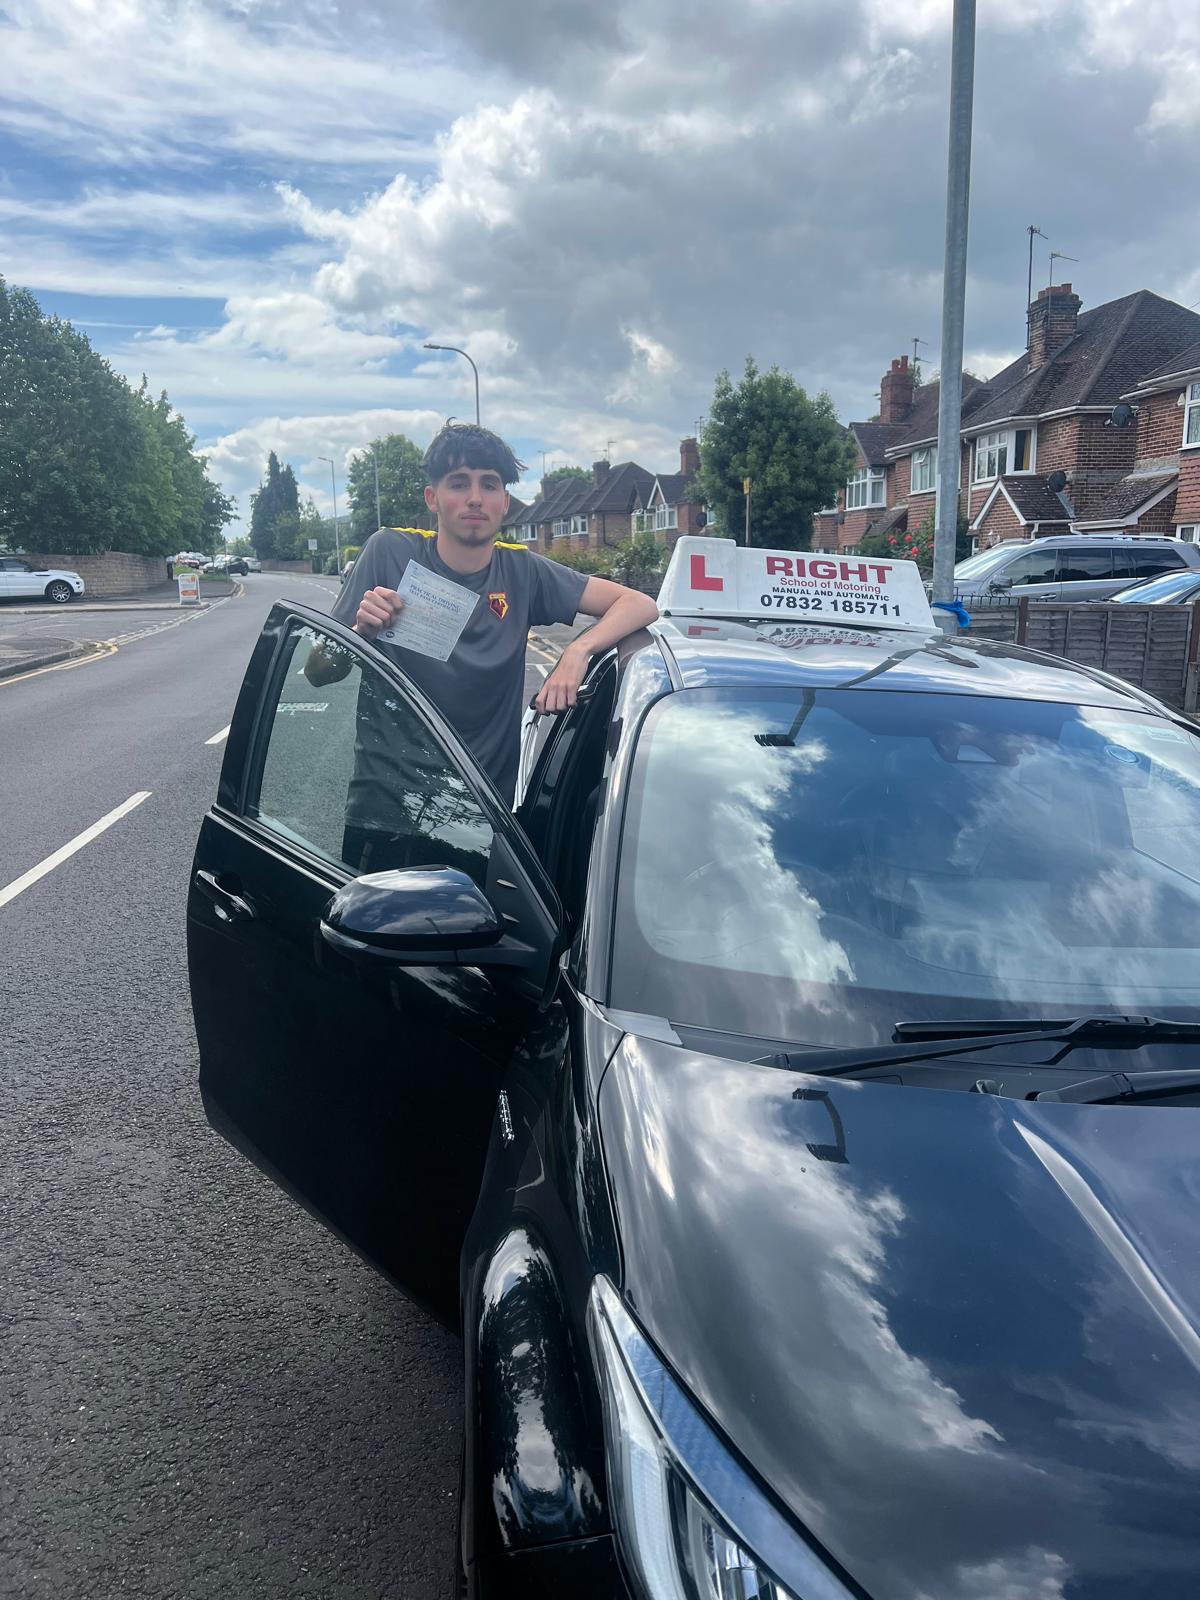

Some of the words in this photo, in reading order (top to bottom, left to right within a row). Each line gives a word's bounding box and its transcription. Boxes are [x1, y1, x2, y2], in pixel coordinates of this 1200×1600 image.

[690, 555, 723, 592] L
[766, 556, 893, 584] RIGHT
[772, 587, 812, 596] MANUAL
[836, 591, 890, 602] AUTOMATIC
[780, 577, 818, 589] School
[820, 580, 833, 590] of
[834, 582, 881, 594] Motoring
[760, 594, 823, 611] 07832
[830, 599, 901, 617] 185711
